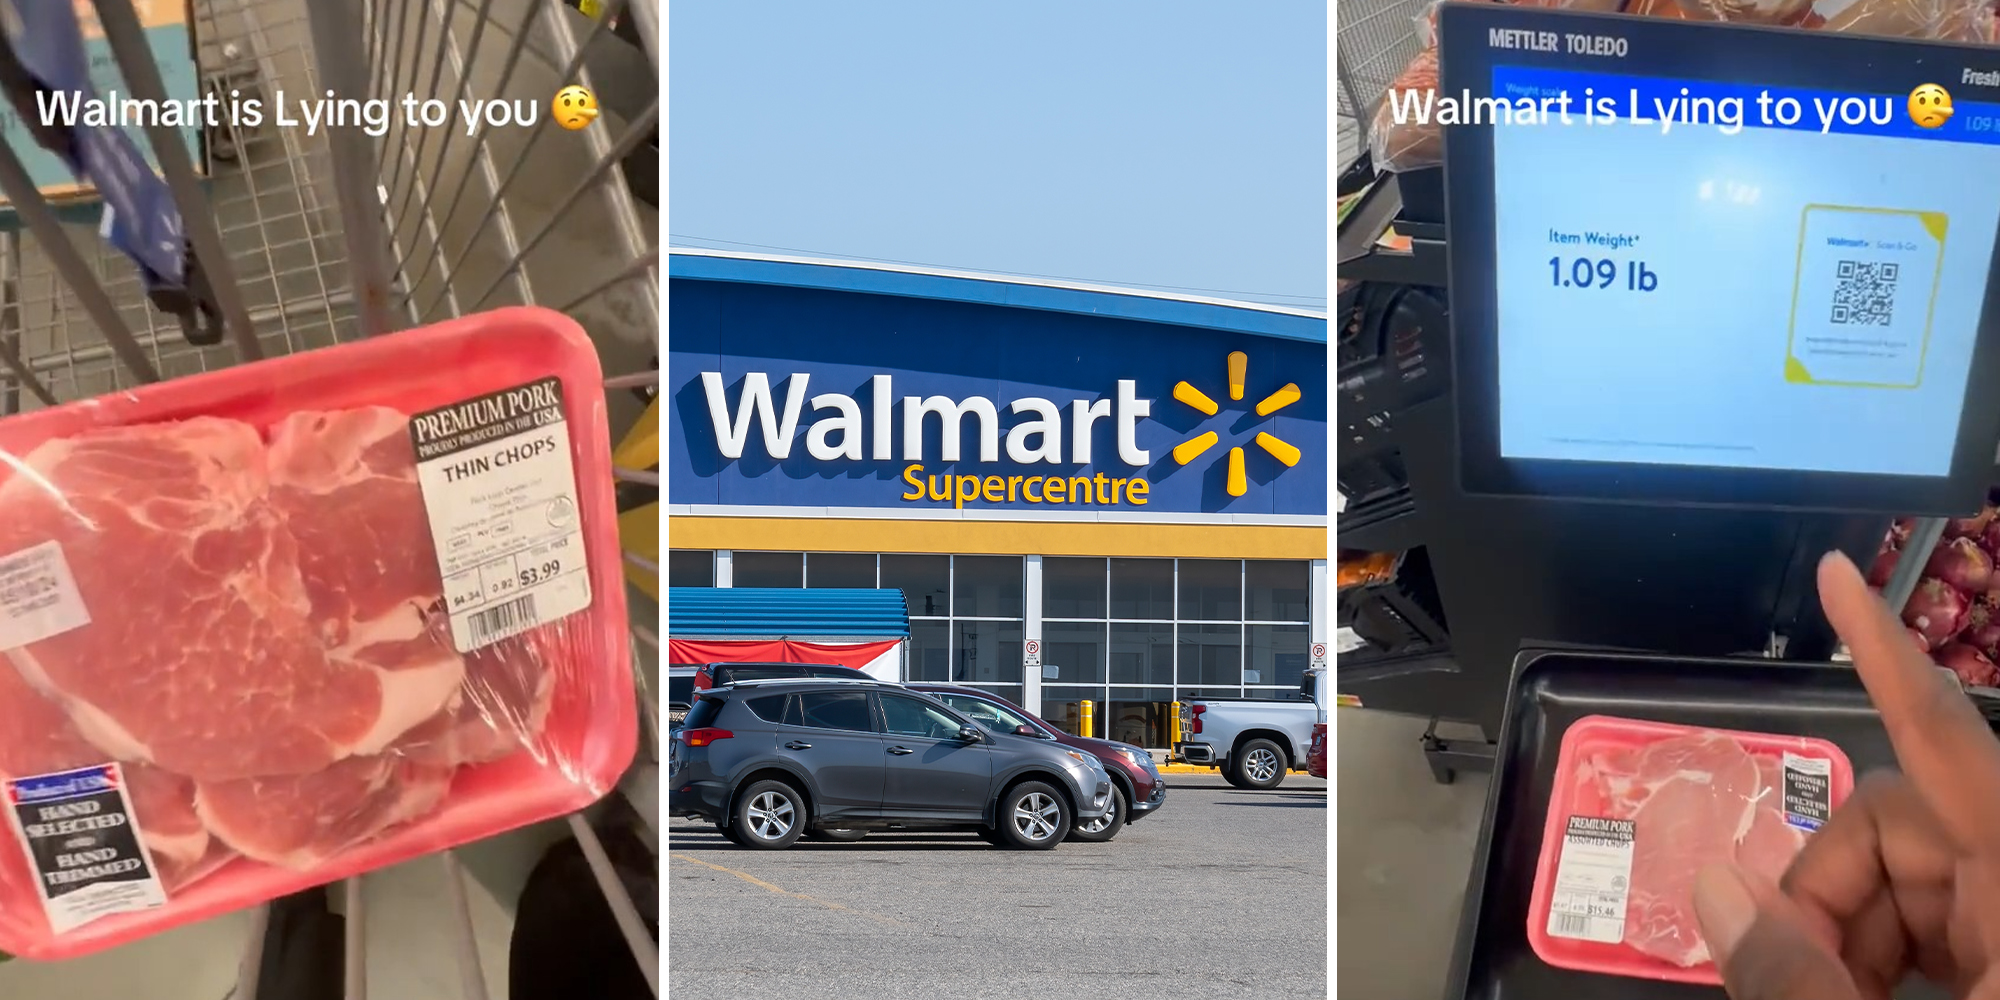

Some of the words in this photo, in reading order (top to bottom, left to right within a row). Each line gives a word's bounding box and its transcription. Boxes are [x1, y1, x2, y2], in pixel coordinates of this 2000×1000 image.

[1489, 27, 1558, 52] METTLER
[1565, 33, 1628, 57] TOLEDO
[1505, 82, 1539, 97] Weight
[1549, 227, 1581, 244] Item
[1549, 256, 1616, 289] 1.09
[1628, 261, 1658, 292] lb
[414, 395, 506, 443] PREMIUM
[507, 381, 560, 415] PORK
[533, 407, 562, 426] USA
[701, 372, 1150, 466] Walmart
[443, 456, 490, 483] THIN
[494, 436, 556, 467] CHOPS
[903, 464, 1149, 509] Supercentre
[520, 559, 561, 587] $3.99
[38, 800, 100, 821] HAND
[26, 812, 125, 838] SELECTED
[1569, 816, 1609, 831] PREMIUM
[1610, 820, 1634, 833] PORK
[55, 847, 118, 868] HAND
